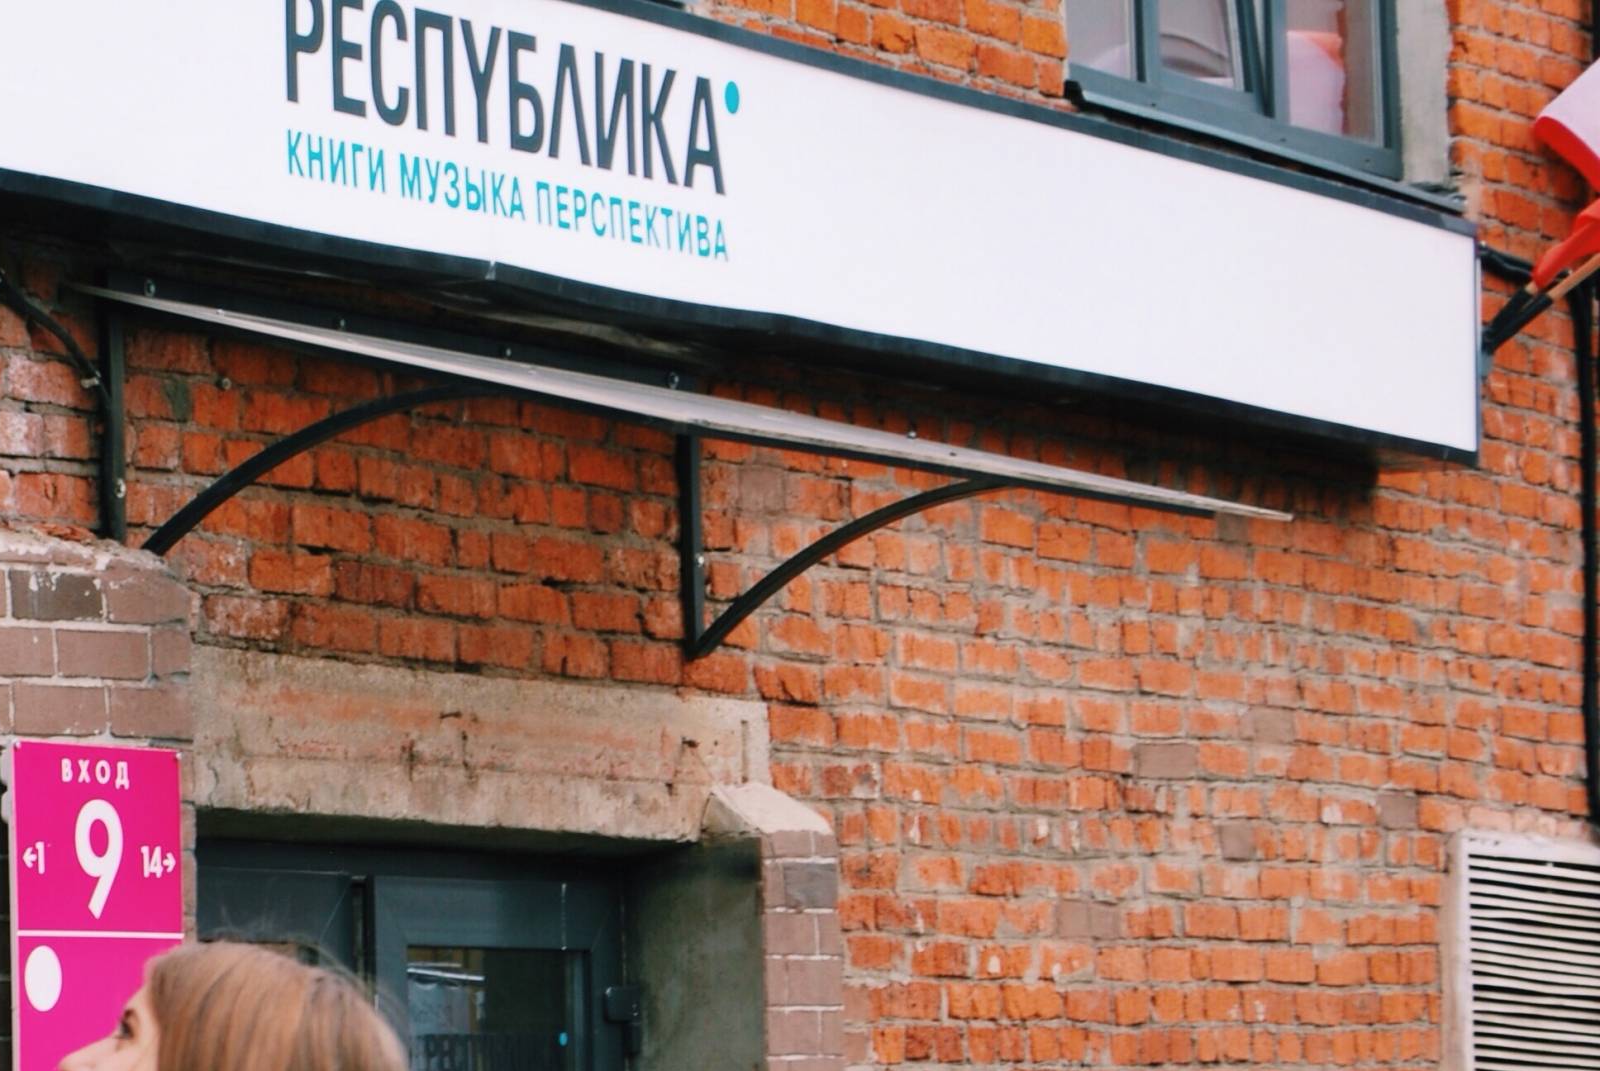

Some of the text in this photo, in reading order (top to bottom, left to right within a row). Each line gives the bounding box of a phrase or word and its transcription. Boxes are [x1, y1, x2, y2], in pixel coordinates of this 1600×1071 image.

[285, 0, 727, 196] РЕСПУБЛИКА
[286, 129, 730, 263] КНИГИ МУЗЫКА ПЕРСПЕКТИВА
[61, 758, 130, 790] ВХОД
[35, 841, 46, 875] 1
[74, 799, 124, 920] 9
[140, 845, 163, 879] 14
